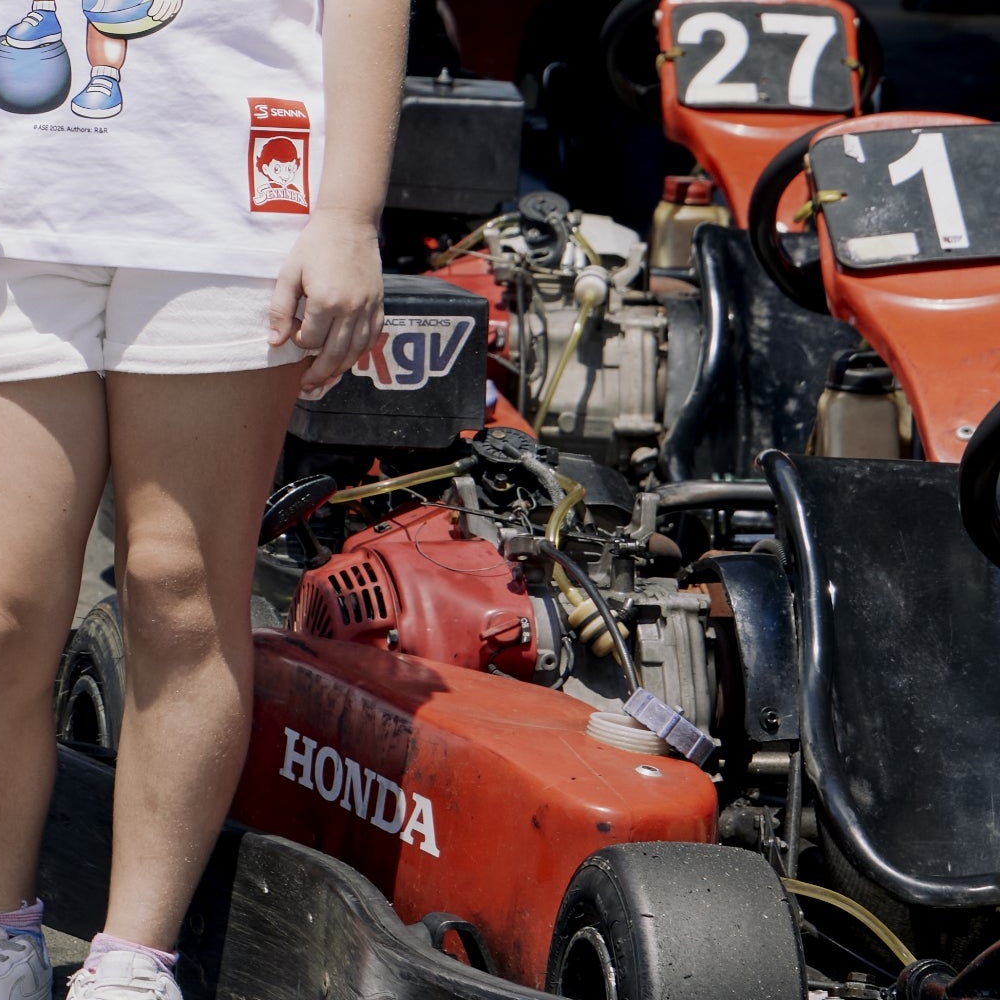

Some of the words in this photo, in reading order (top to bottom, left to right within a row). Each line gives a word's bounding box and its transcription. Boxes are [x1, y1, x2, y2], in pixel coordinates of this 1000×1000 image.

[677, 12, 837, 107] 27
[270, 107, 307, 118] SENNA
[888, 133, 970, 249] 1
[384, 318, 405, 327] ACE
[408, 318, 451, 327] TRACKS
[279, 726, 441, 858] HONDA
